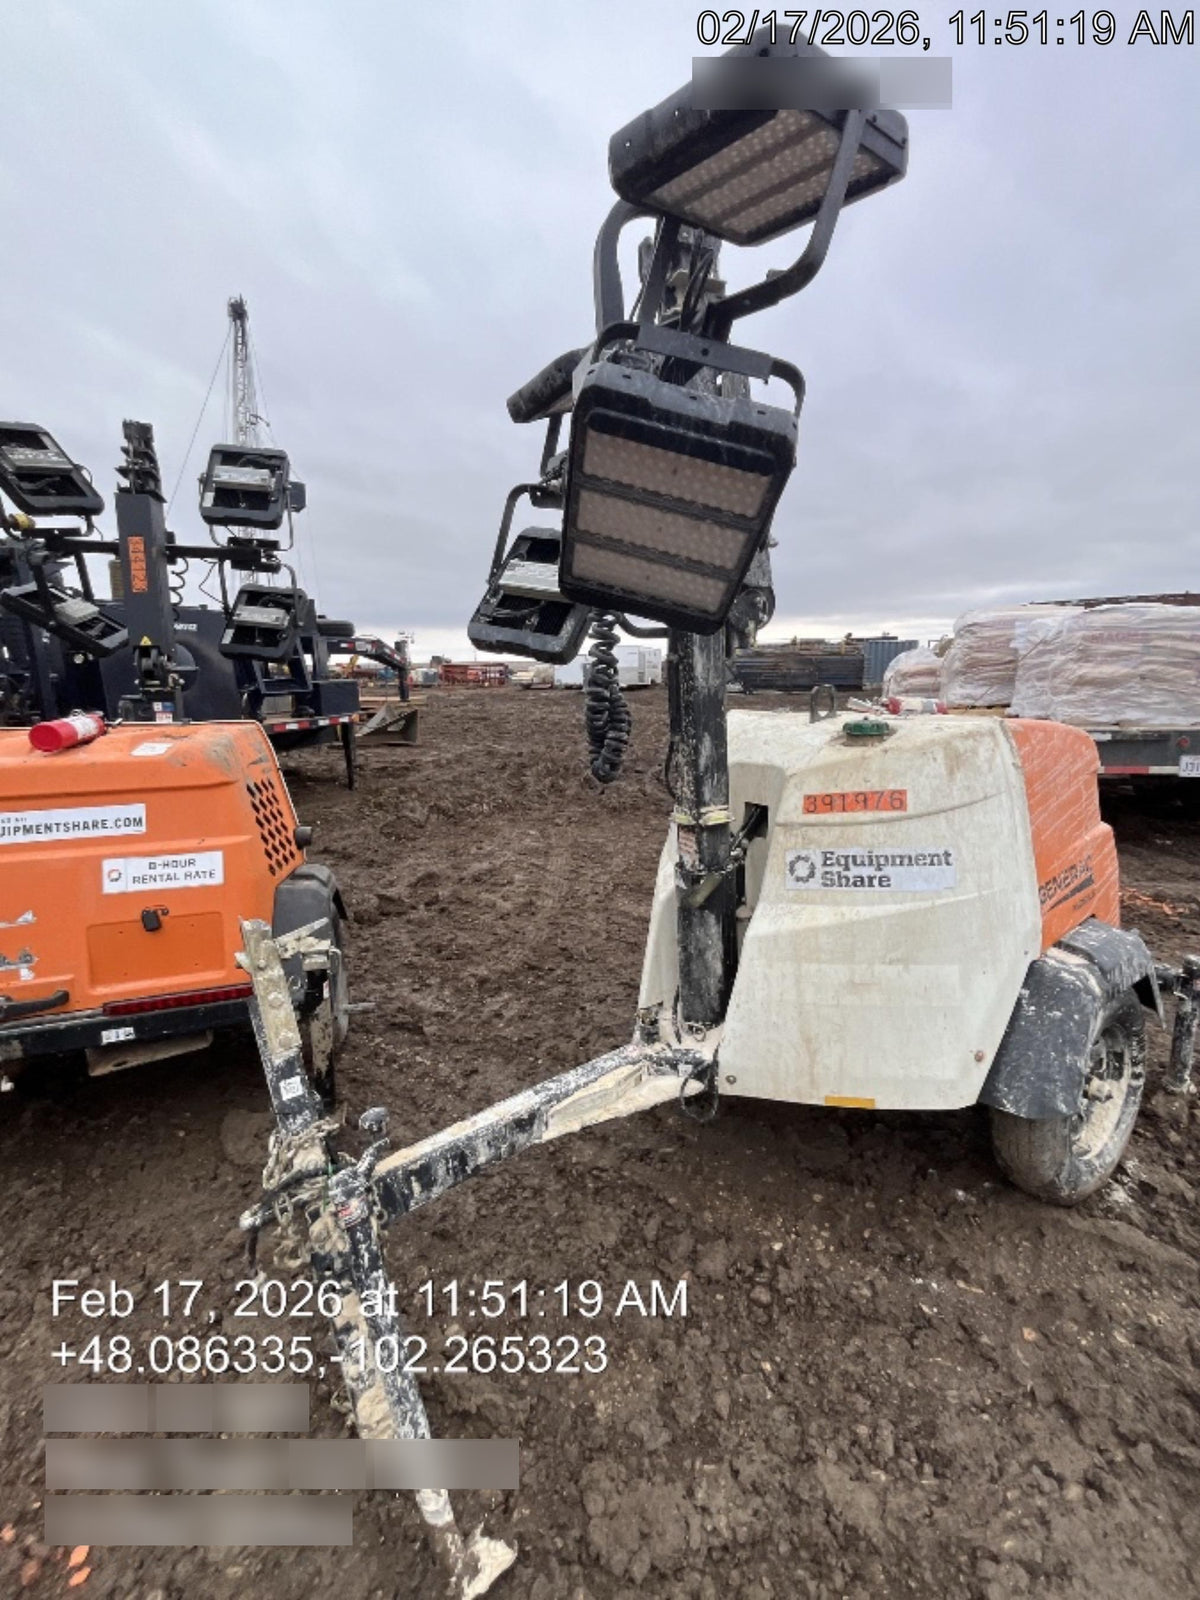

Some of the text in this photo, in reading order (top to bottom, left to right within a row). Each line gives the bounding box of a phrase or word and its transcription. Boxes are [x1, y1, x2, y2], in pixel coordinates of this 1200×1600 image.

[804, 791, 905, 813] 391976
[820, 850, 953, 871] Equipment
[132, 869, 217, 885] RENTAL RATE
[820, 870, 892, 888] Share
